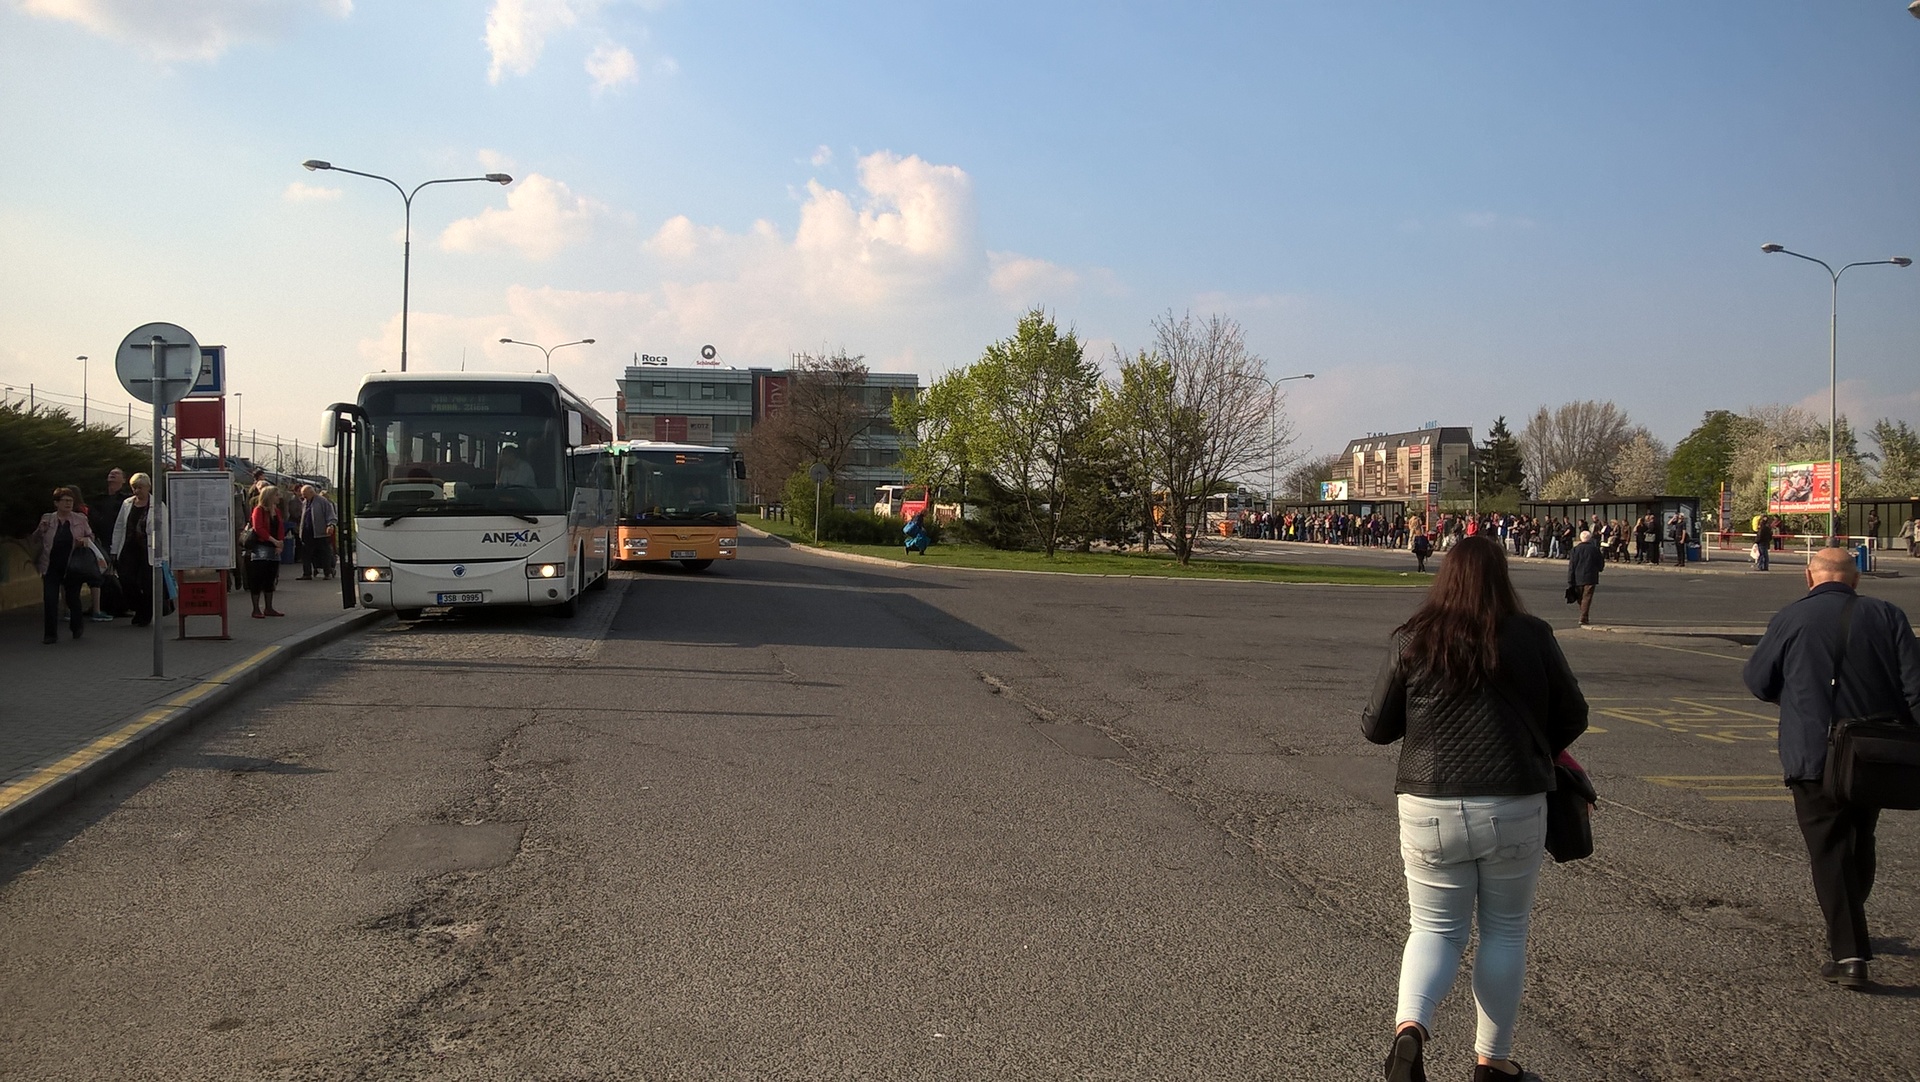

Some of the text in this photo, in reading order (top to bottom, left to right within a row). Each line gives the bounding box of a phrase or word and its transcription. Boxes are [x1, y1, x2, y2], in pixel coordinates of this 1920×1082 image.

[642, 354, 668, 362] Roca
[481, 530, 541, 545] ANEXIA
[443, 593, 480, 602] 3SB 0995
